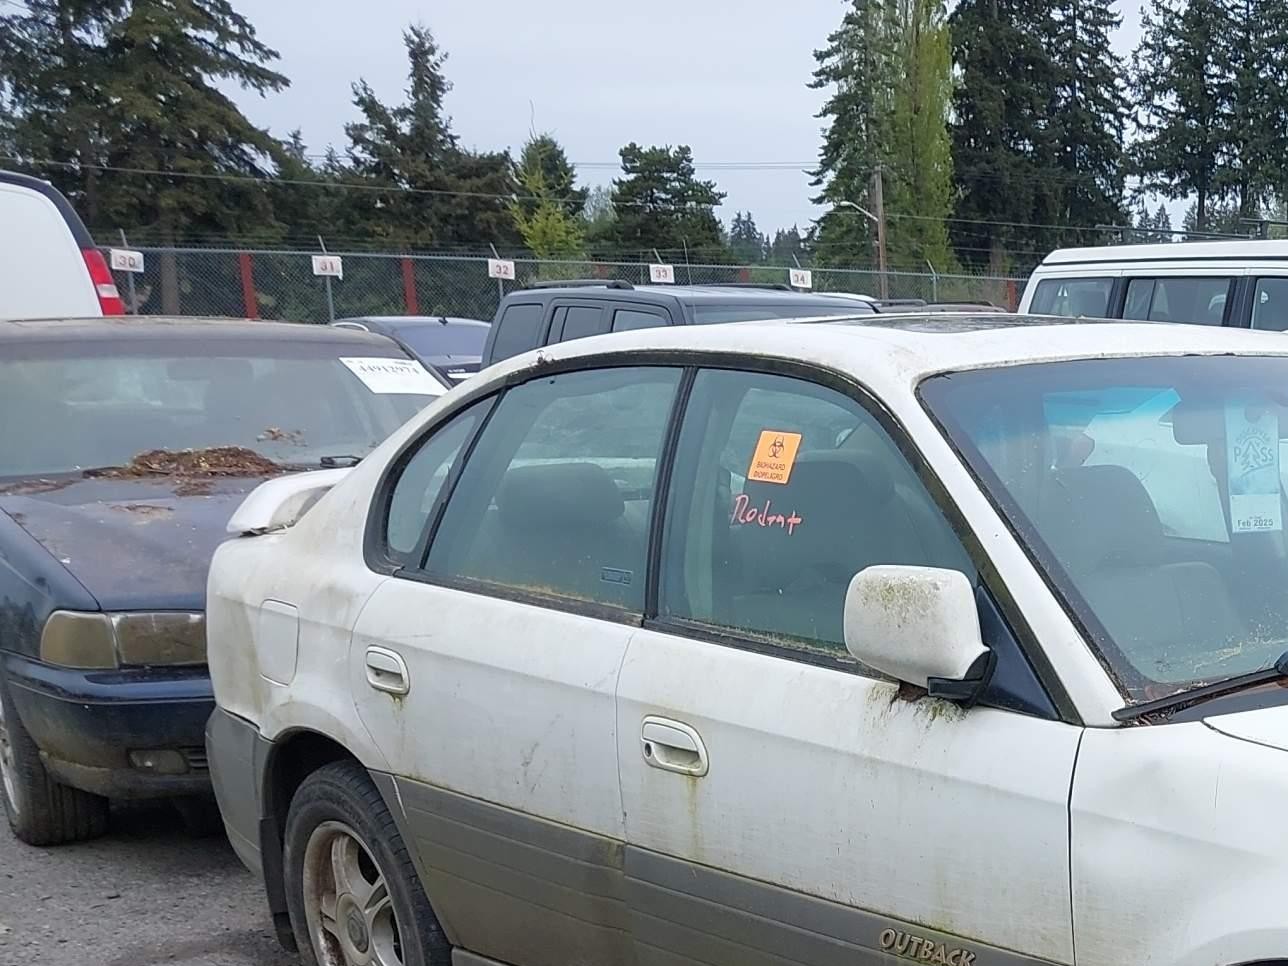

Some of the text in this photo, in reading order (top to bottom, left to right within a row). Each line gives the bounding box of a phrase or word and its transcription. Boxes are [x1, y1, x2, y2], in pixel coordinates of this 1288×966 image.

[119, 255, 136, 268] 30
[495, 264, 509, 275] 32
[655, 268, 668, 279] 33
[756, 461, 786, 471] BIOHAZARD
[1237, 518, 1274, 528] Feb 2025
